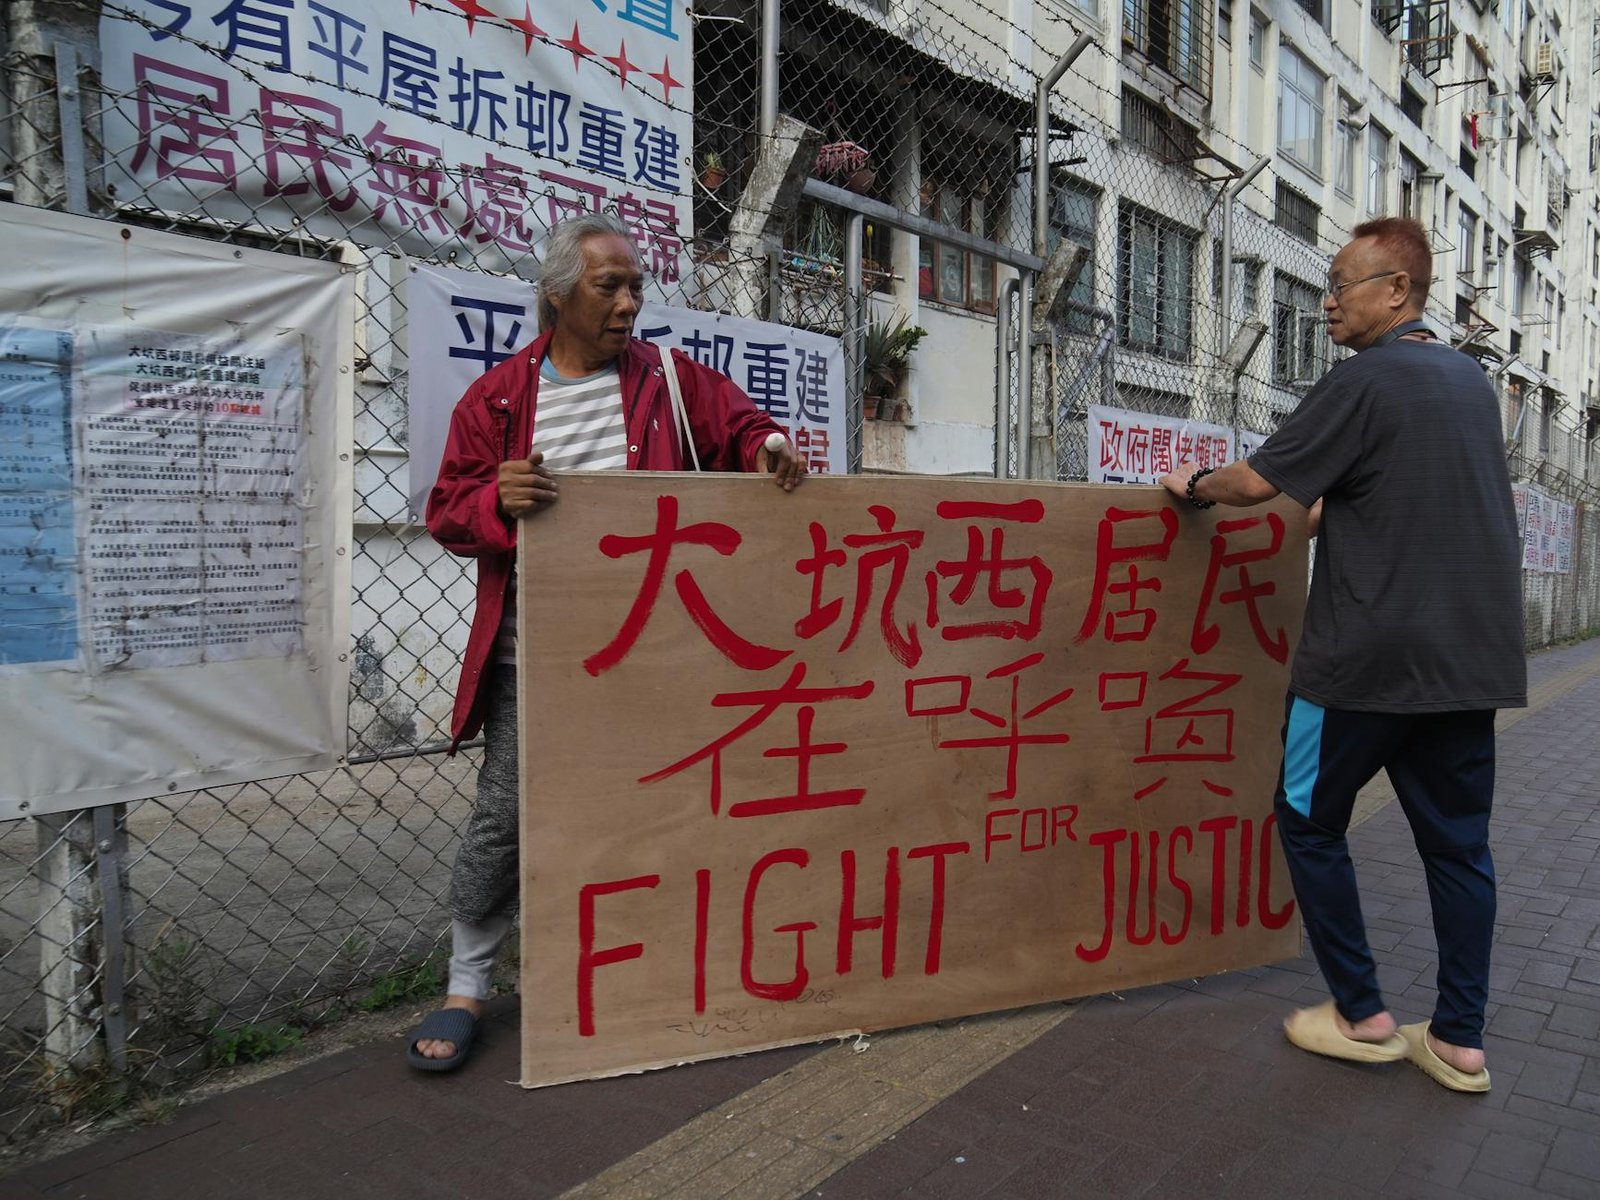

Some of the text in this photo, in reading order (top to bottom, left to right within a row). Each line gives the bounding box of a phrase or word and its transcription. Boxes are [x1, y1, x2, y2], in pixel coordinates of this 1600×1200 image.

[582, 495, 1289, 678] 大坑西居民
[576, 841, 971, 1038] FIGHT
[984, 804, 1080, 863] FOR
